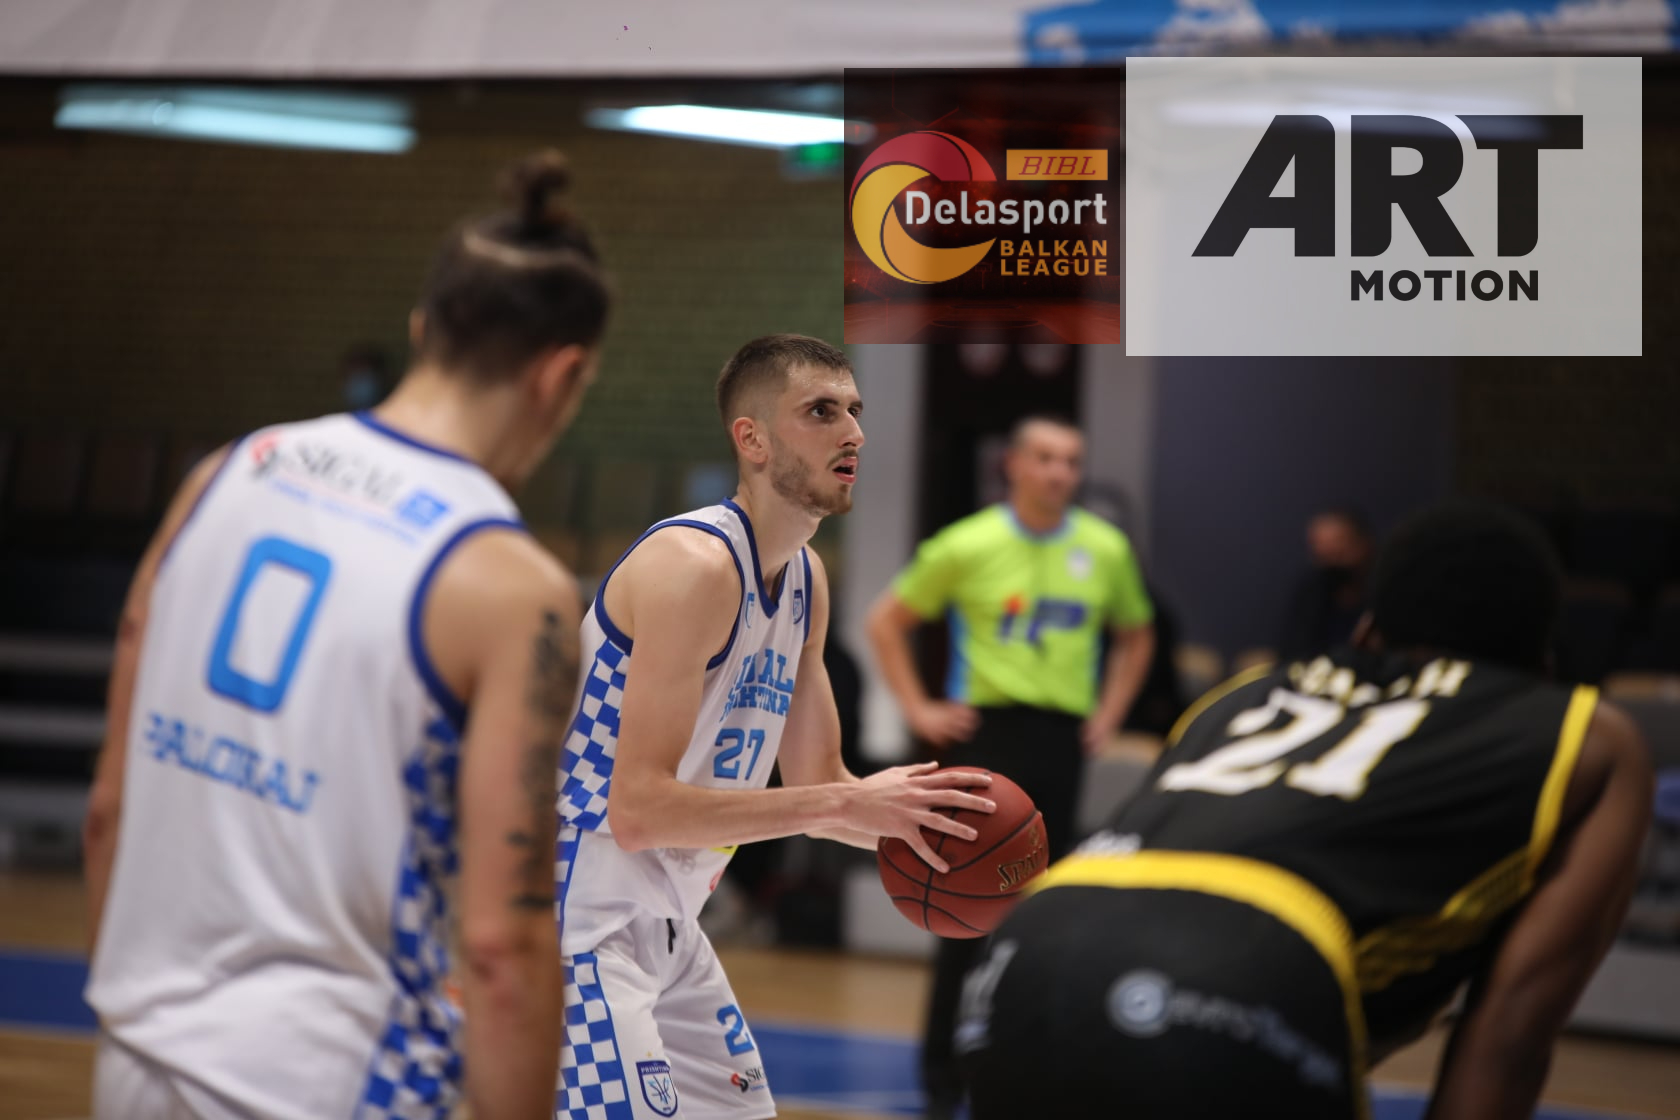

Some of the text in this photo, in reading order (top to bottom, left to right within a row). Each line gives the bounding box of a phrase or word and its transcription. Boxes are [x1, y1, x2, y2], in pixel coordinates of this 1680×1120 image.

[206, 533, 333, 714] 0
[713, 728, 765, 780] 27
[1157, 687, 1431, 799] 21
